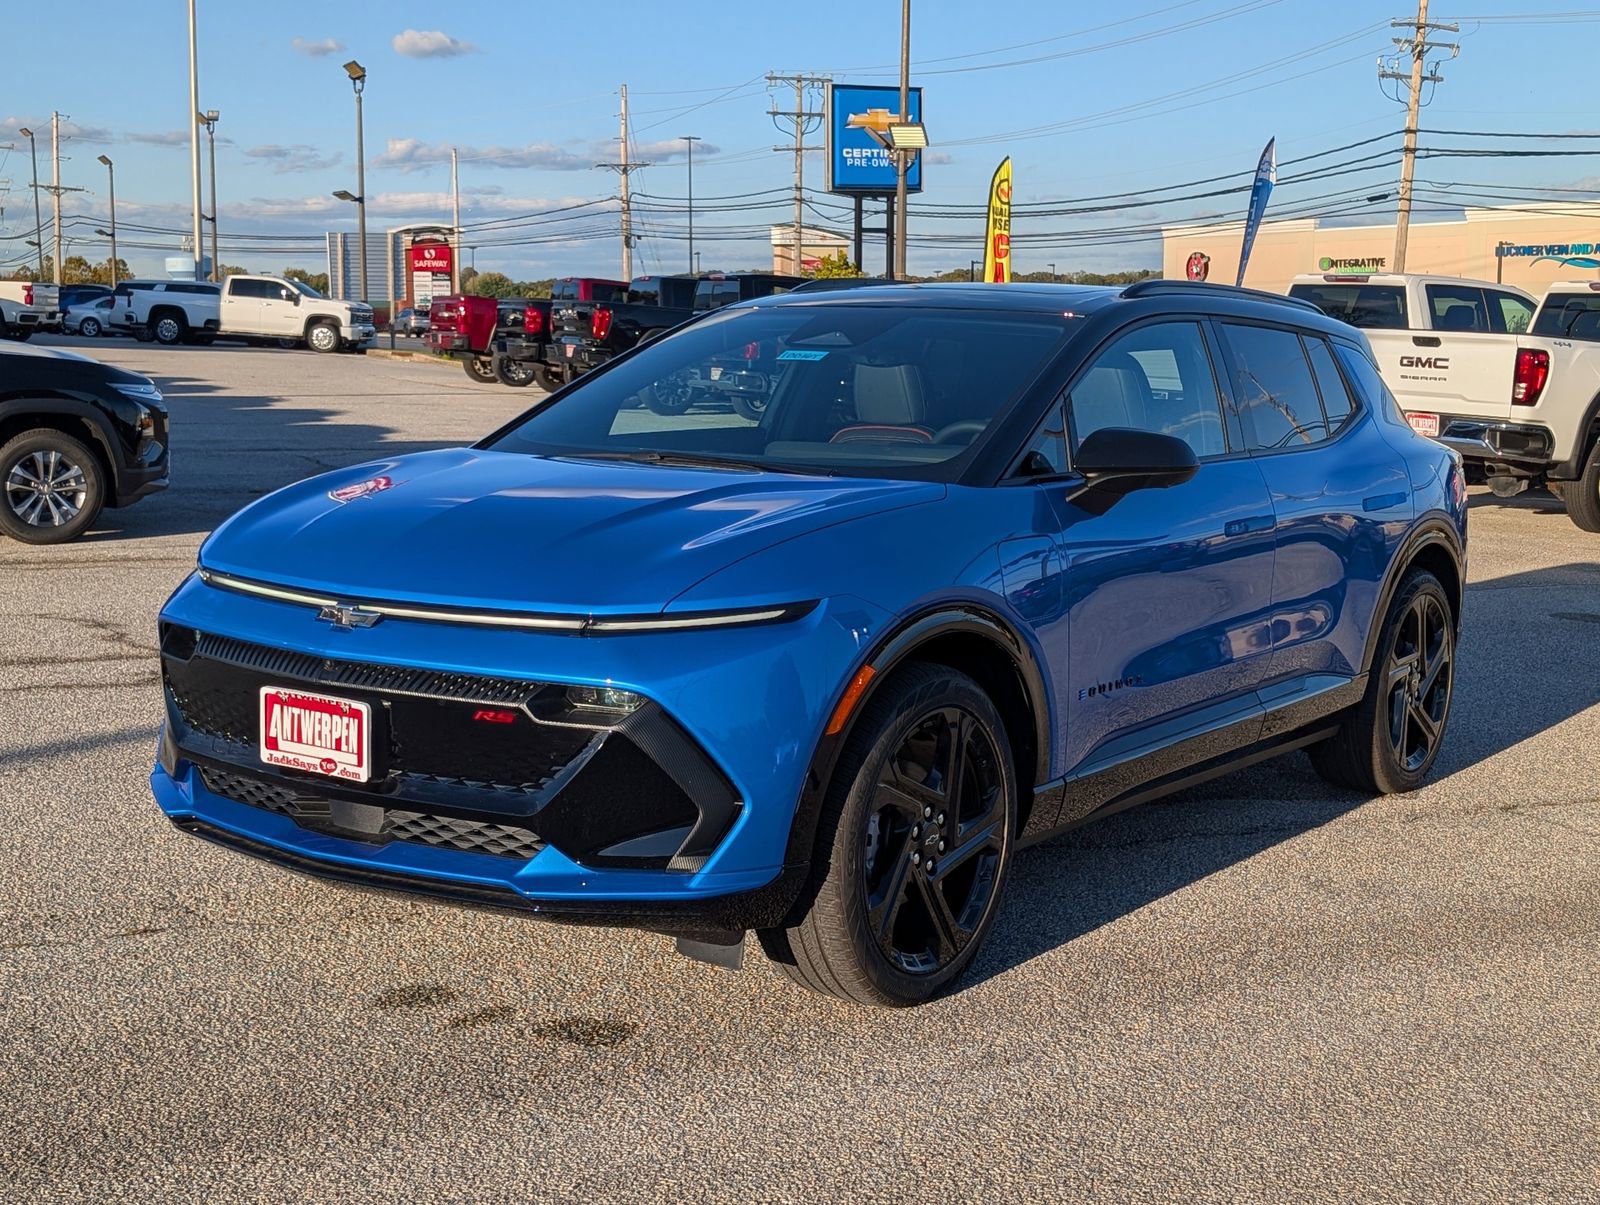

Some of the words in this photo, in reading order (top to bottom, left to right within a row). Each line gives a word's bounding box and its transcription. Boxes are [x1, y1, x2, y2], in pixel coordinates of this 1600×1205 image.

[842, 148, 891, 158] CERTIF
[846, 158, 912, 168] PRE-OW
[1570, 243, 1594, 255] AND
[414, 260, 448, 268] SAFEWAY
[1400, 356, 1450, 369] GMC
[474, 711, 514, 724] RS
[269, 703, 359, 755] ANTWERPEN
